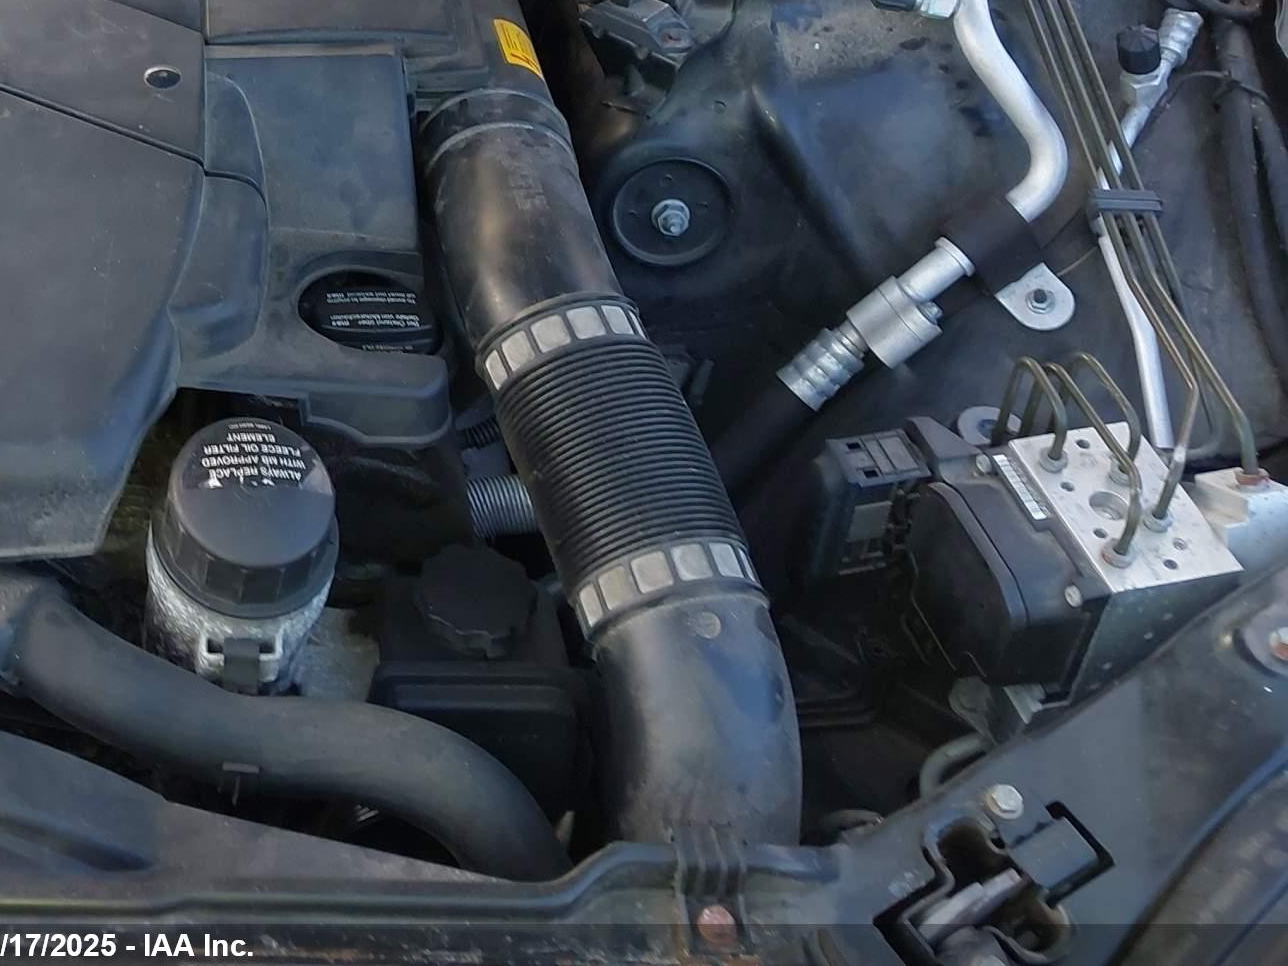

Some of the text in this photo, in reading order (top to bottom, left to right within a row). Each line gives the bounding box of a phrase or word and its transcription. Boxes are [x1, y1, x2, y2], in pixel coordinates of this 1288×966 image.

[226, 432, 276, 443] ELEMENT
[203, 443, 301, 457] FLEECE OIL FILTER
[201, 455, 259, 468] APPROVED
[279, 455, 306, 469] WITH
[260, 466, 302, 481] ALWAYS
